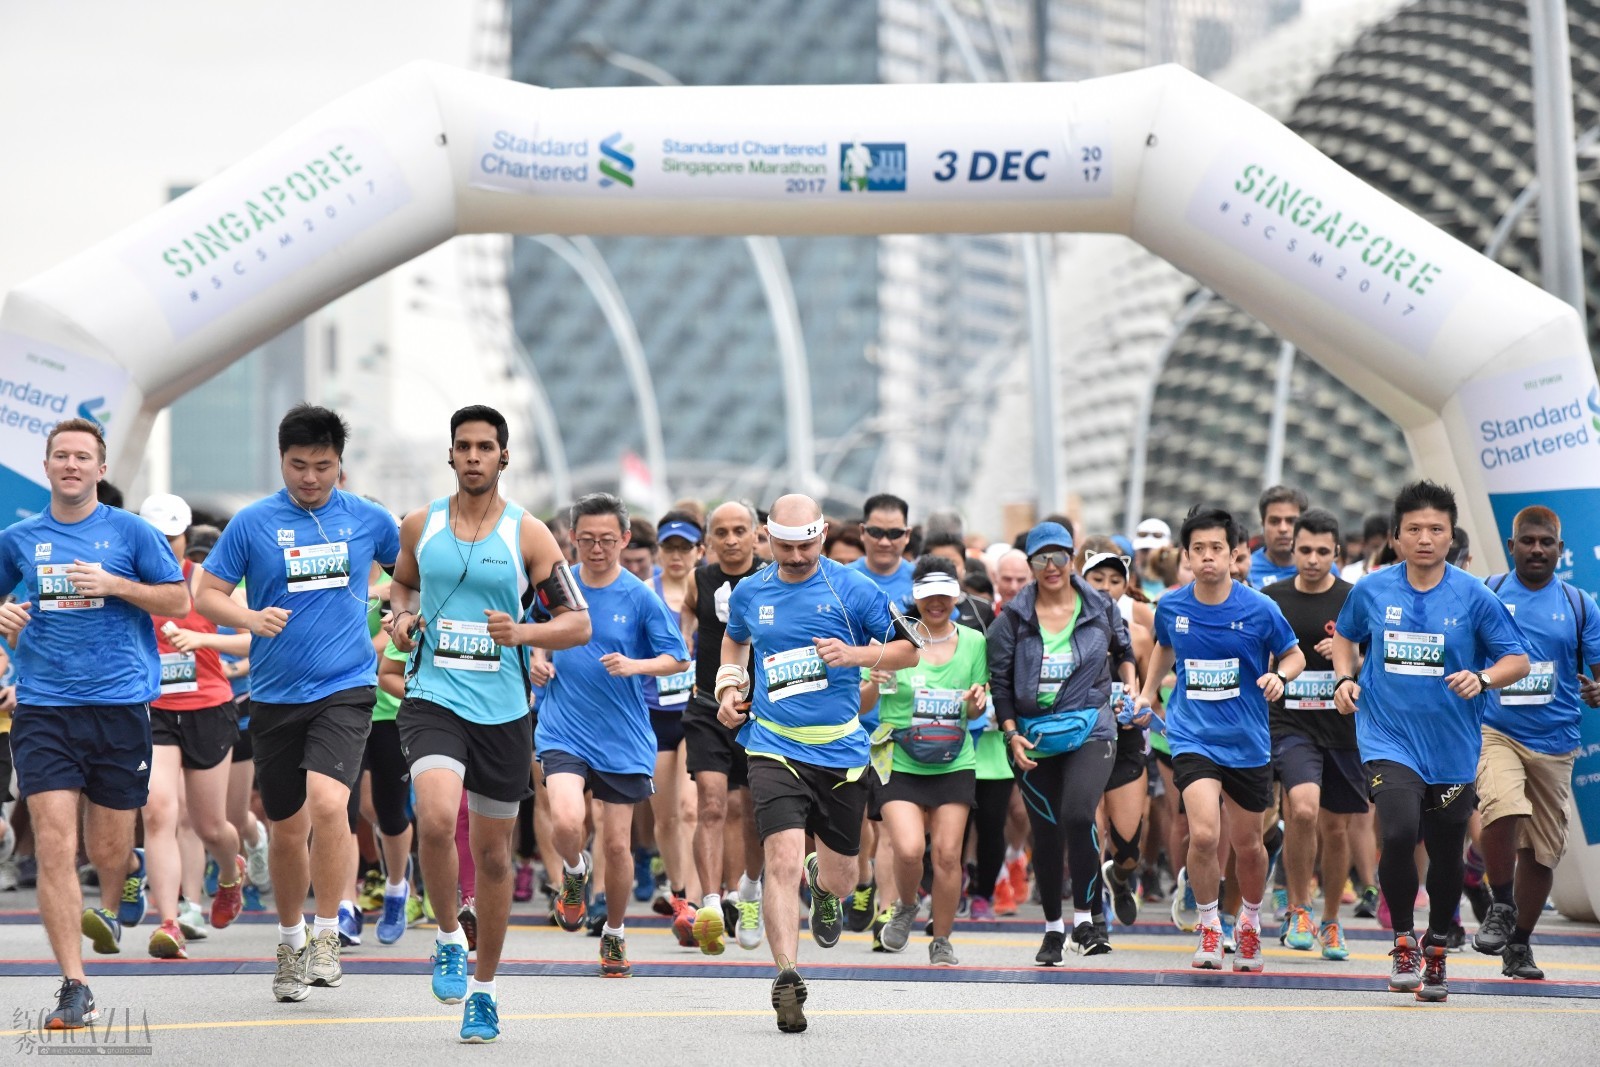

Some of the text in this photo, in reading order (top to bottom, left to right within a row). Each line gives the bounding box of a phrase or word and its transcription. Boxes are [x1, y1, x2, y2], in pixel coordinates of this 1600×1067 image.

[492, 130, 588, 158] Standard
[662, 139, 827, 156] Standard Chartered
[1081, 146, 1102, 162] 20
[480, 153, 588, 182] Chartered
[662, 157, 827, 177] Singapore Marathon
[934, 150, 1050, 183] 3 DEC
[1082, 167, 1102, 183] 17
[785, 178, 826, 193] 2017
[161, 143, 364, 279] SINGAPORE
[1234, 164, 1442, 297] SINGAPORE
[0, 378, 68, 414] ndard
[1480, 397, 1582, 443] Standard
[1480, 423, 1589, 470] Chartered
[290, 556, 345, 576] B51997
[481, 556, 508, 566] Micron
[439, 632, 497, 656] B41581
[1387, 643, 1441, 661] B51326
[162, 663, 193, 681] 8876
[768, 659, 821, 685] B51022
[1040, 664, 1075, 679] B516
[1188, 671, 1236, 686] B50482
[1288, 681, 1334, 697] B41868
[1503, 676, 1549, 691] 3875
[917, 700, 960, 714] B51682
